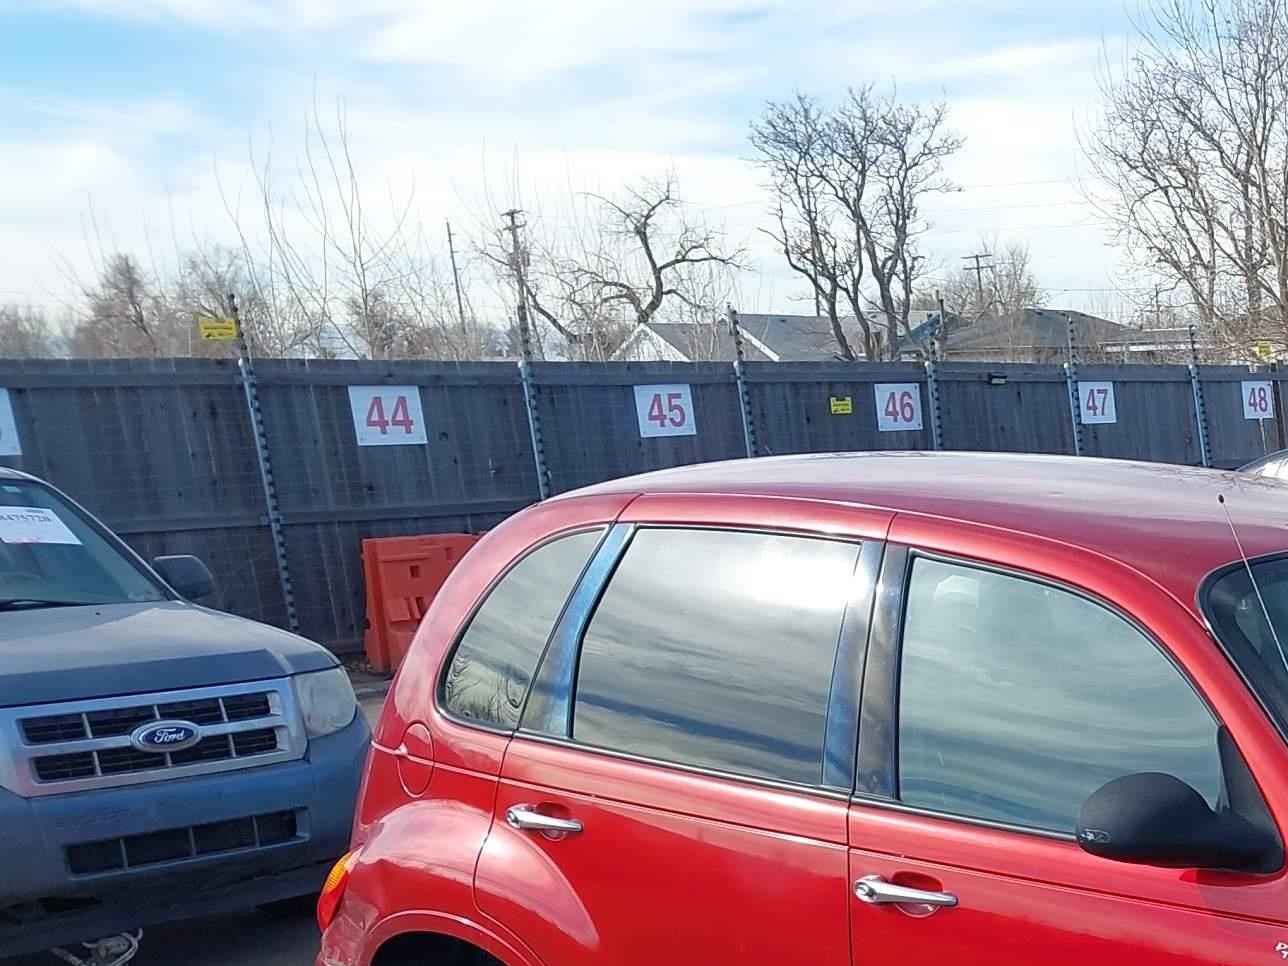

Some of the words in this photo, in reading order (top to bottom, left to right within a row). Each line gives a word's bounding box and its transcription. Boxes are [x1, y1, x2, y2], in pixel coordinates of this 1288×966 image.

[647, 393, 686, 428] 45
[884, 391, 914, 423] 46
[1086, 389, 1108, 416] 47
[1248, 387, 1268, 413] 48
[366, 395, 414, 435] 44
[154, 728, 186, 744] Ford
